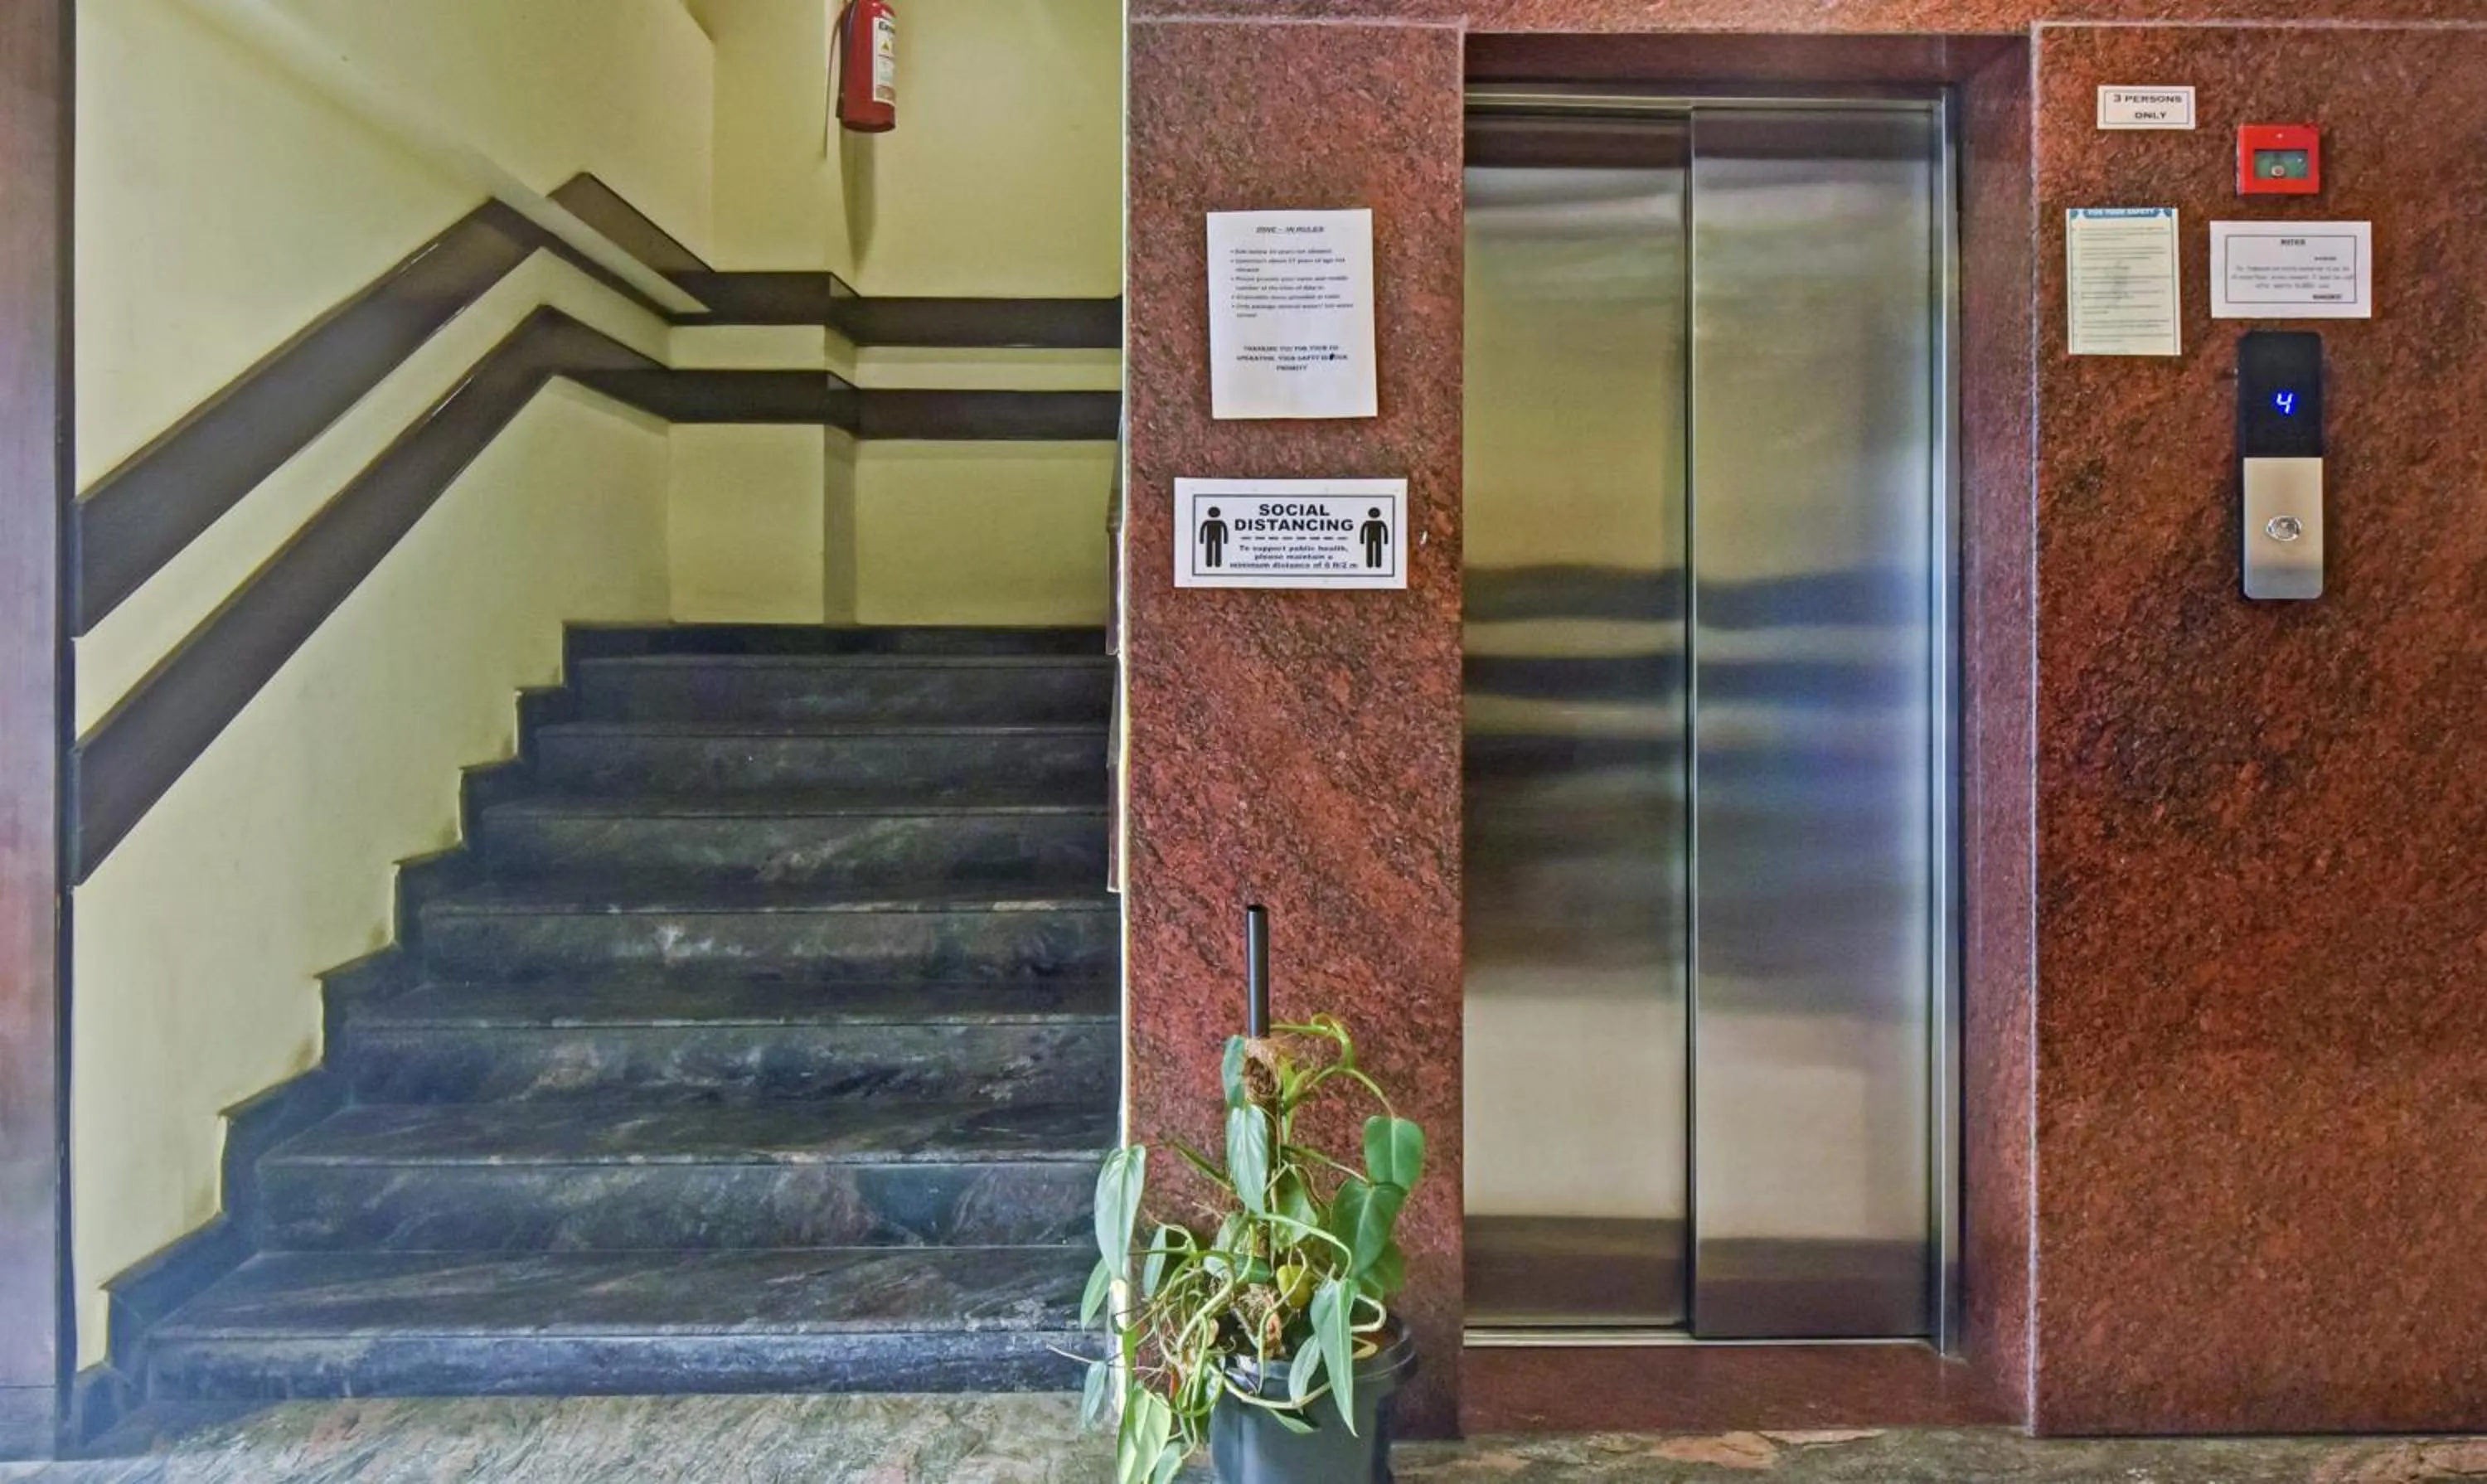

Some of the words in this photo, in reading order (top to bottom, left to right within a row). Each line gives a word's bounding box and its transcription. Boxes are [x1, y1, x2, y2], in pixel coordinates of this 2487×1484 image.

[2112, 94, 2121, 103] 3
[2124, 95, 2183, 104] PERSONS
[2134, 111, 2167, 120] ONLY
[2276, 393, 2294, 415] 4
[1259, 503, 1331, 516] SOCIAL
[1234, 518, 1355, 532] DISTANCING
[1288, 545, 1316, 553] public
